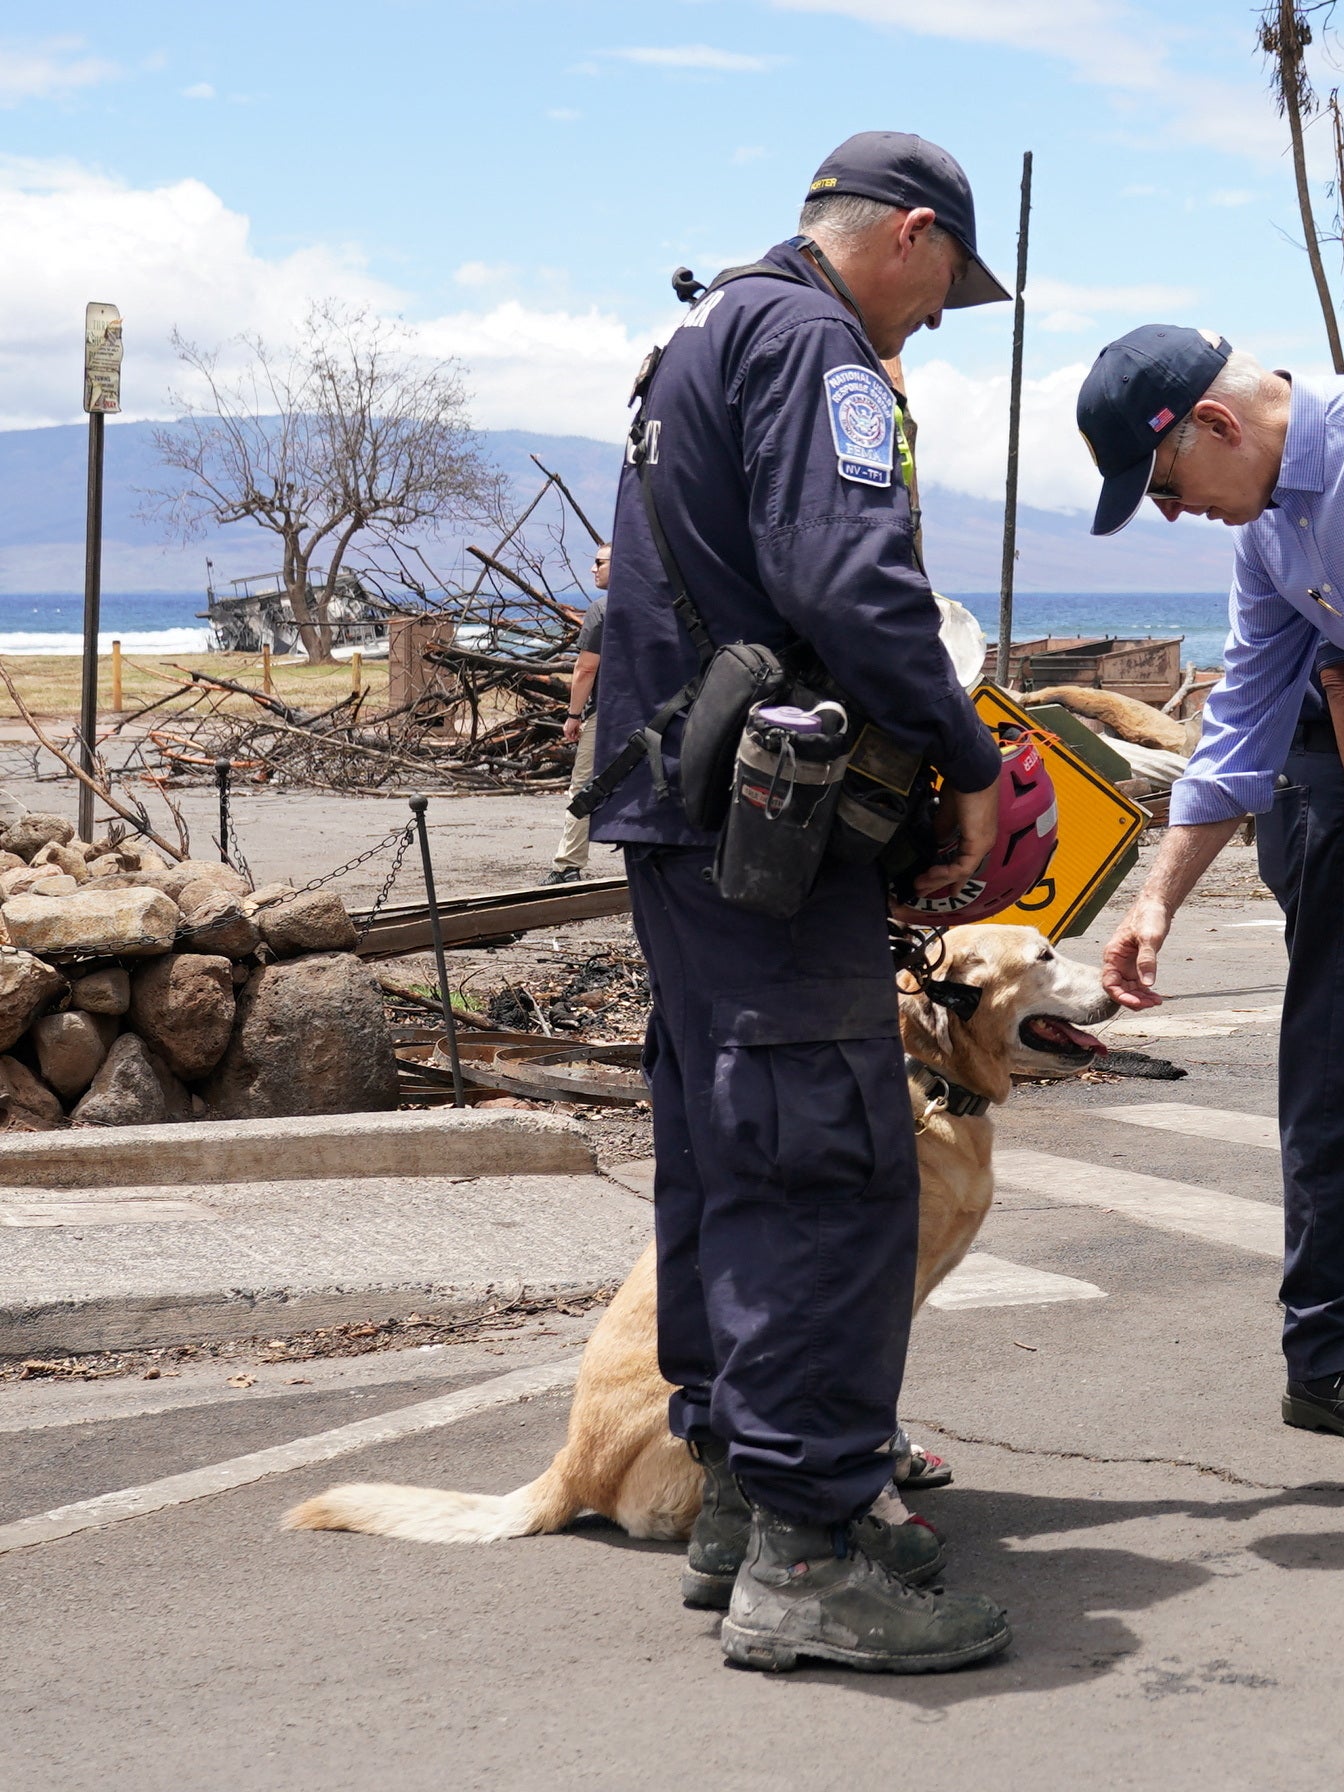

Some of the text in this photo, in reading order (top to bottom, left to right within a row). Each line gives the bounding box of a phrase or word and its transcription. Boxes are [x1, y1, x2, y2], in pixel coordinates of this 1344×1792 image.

[829, 371, 871, 388] NATIONAL
[832, 382, 869, 403] RESPONSE
[845, 442, 881, 462] FEMA
